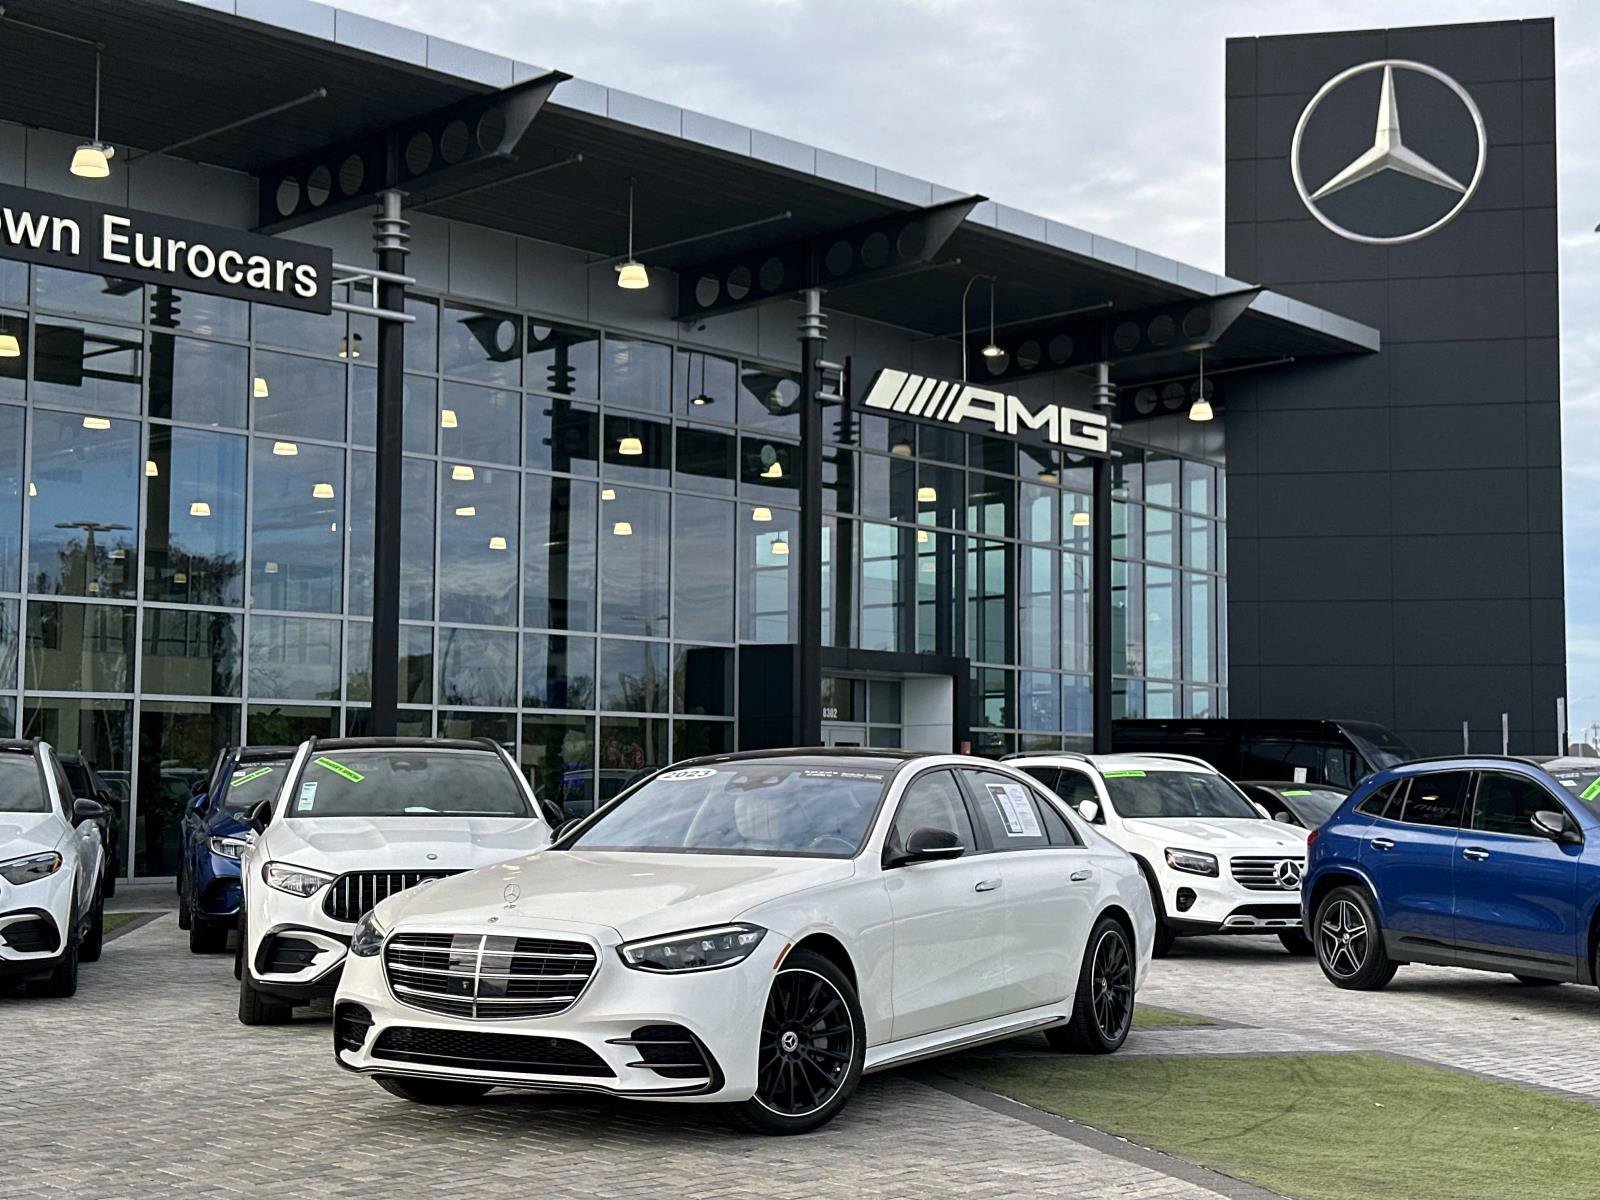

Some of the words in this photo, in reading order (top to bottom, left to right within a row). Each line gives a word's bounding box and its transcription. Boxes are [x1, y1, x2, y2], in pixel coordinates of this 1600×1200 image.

[0, 207, 80, 255] wn
[103, 214, 318, 297] Eurocars
[948, 386, 1107, 452] AMG
